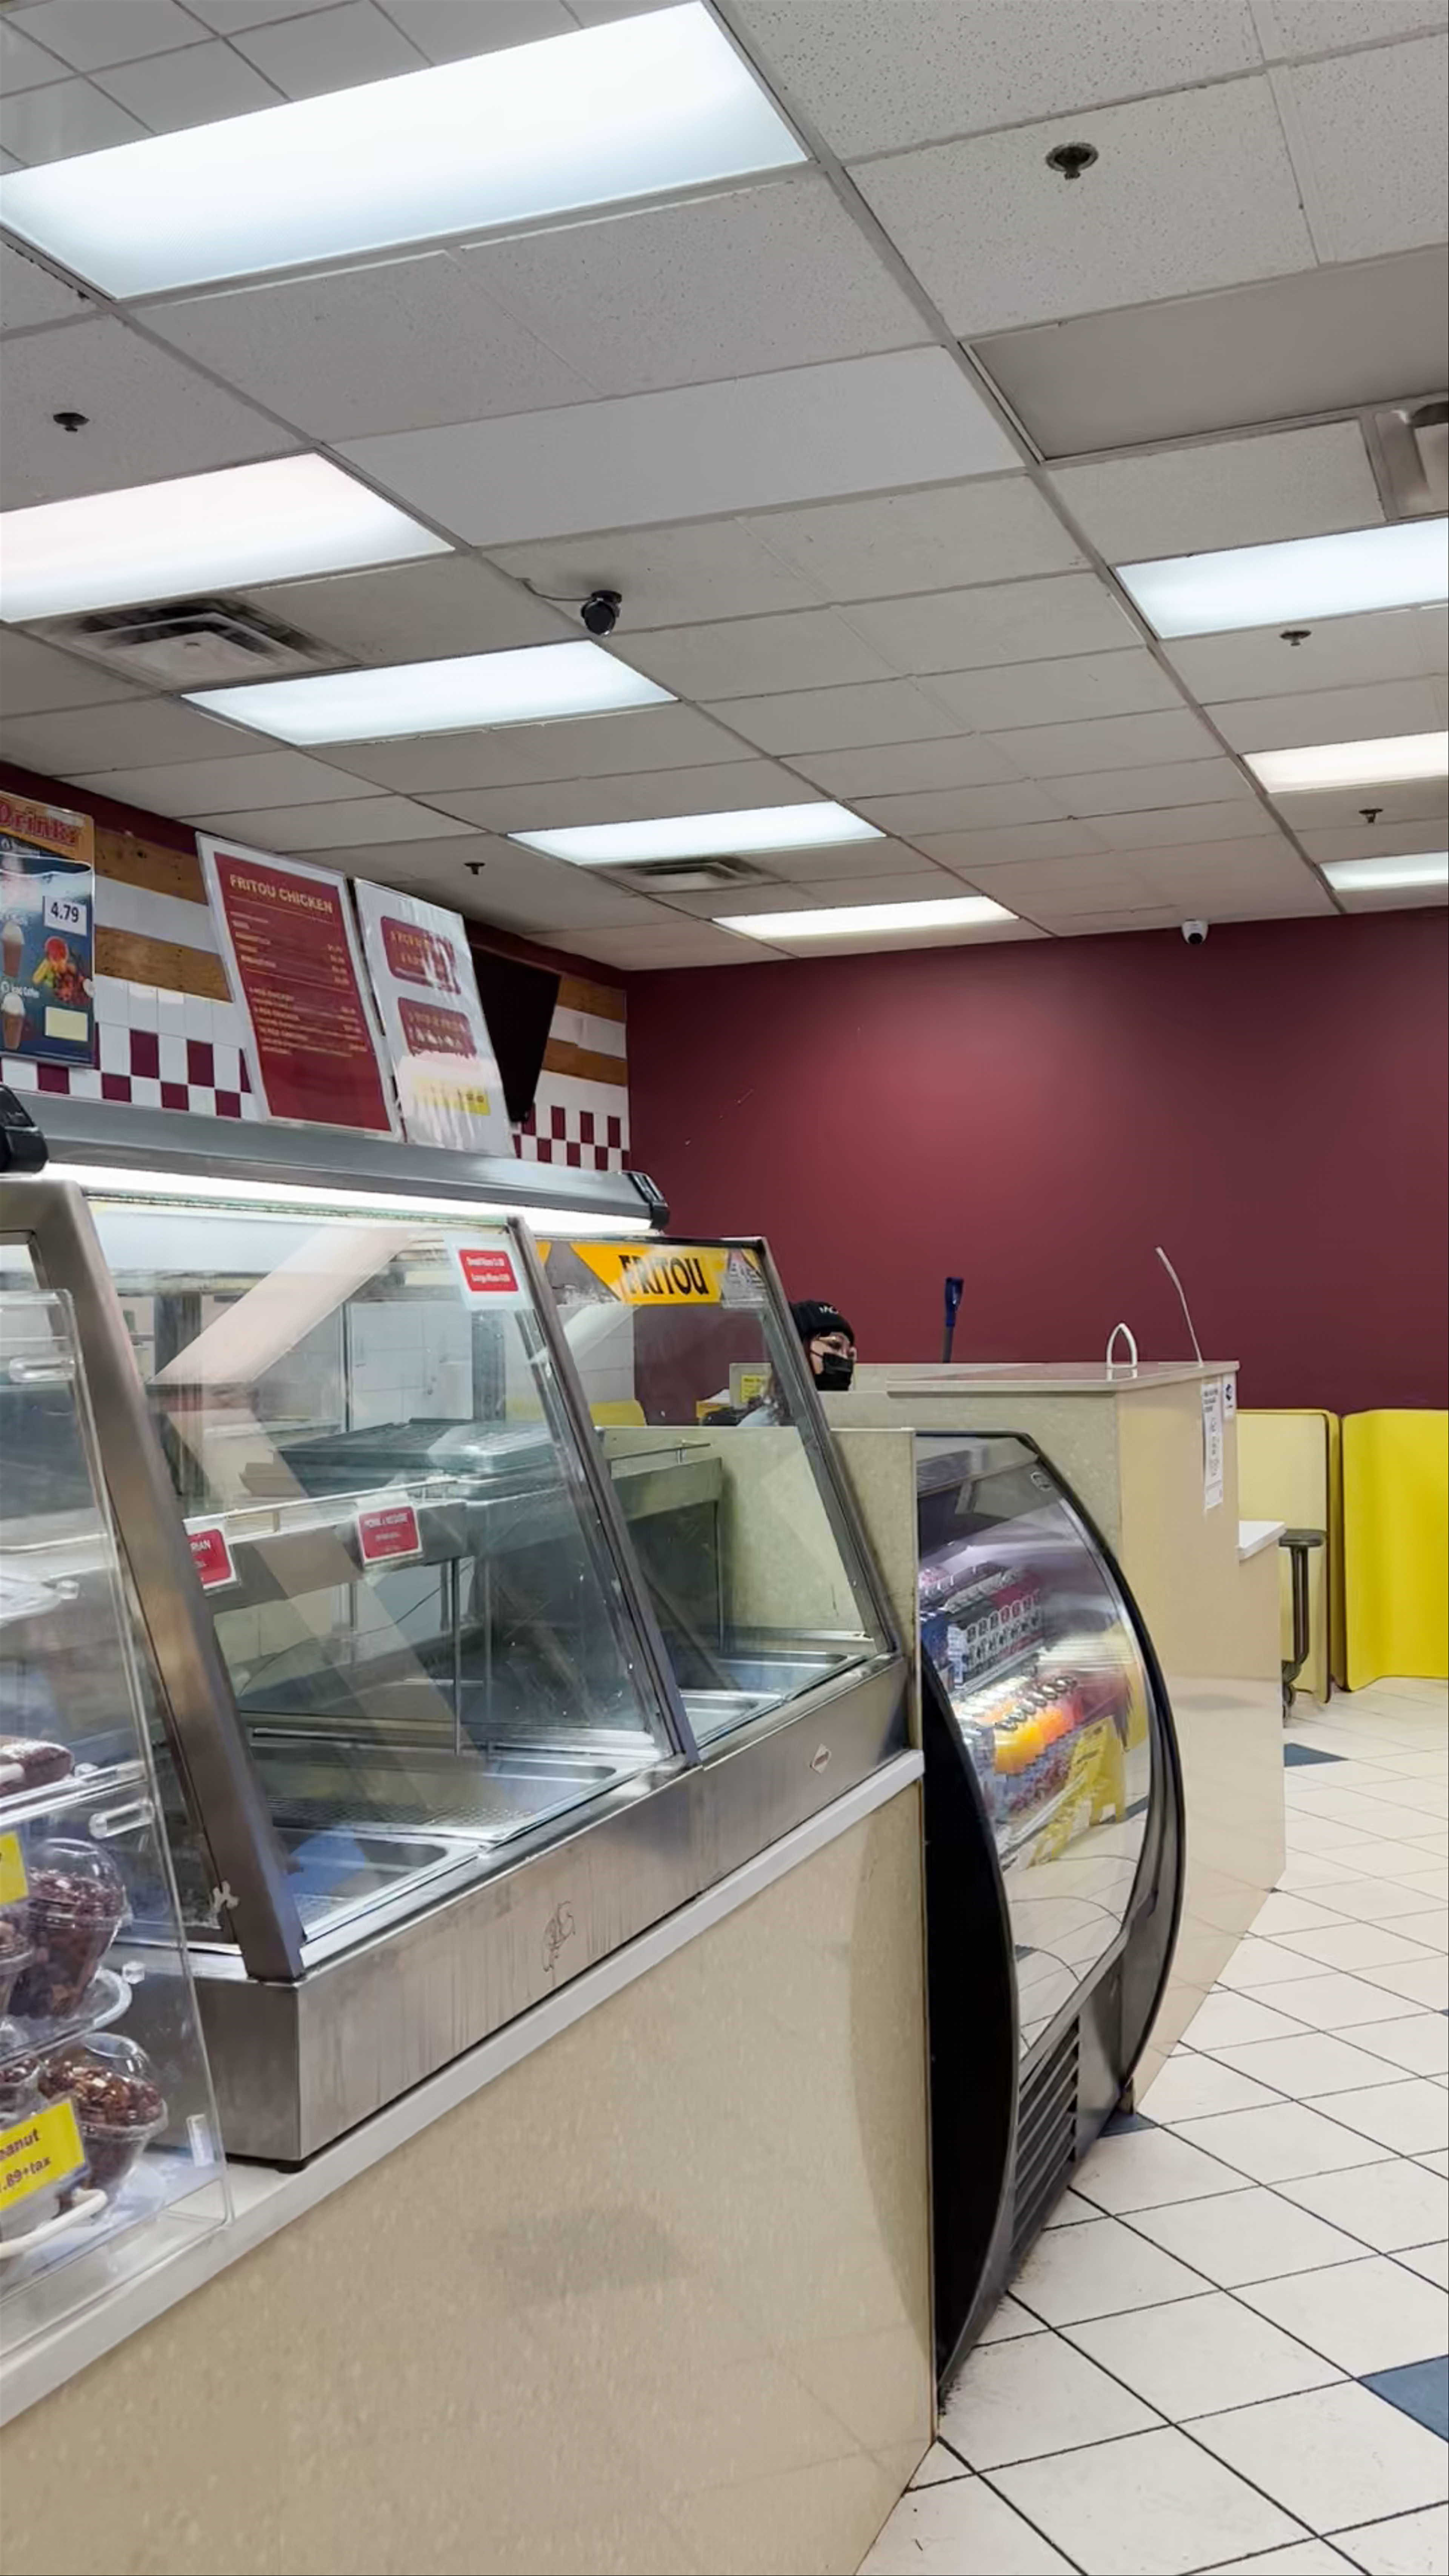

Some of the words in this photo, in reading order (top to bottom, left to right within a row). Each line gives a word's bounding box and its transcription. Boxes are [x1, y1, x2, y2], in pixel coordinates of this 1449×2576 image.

[51, 902, 79, 923] 4.79
[230, 874, 276, 897] FRITOU
[279, 888, 332, 914] CHICKEN
[619, 1255, 709, 1295] FRITOU
